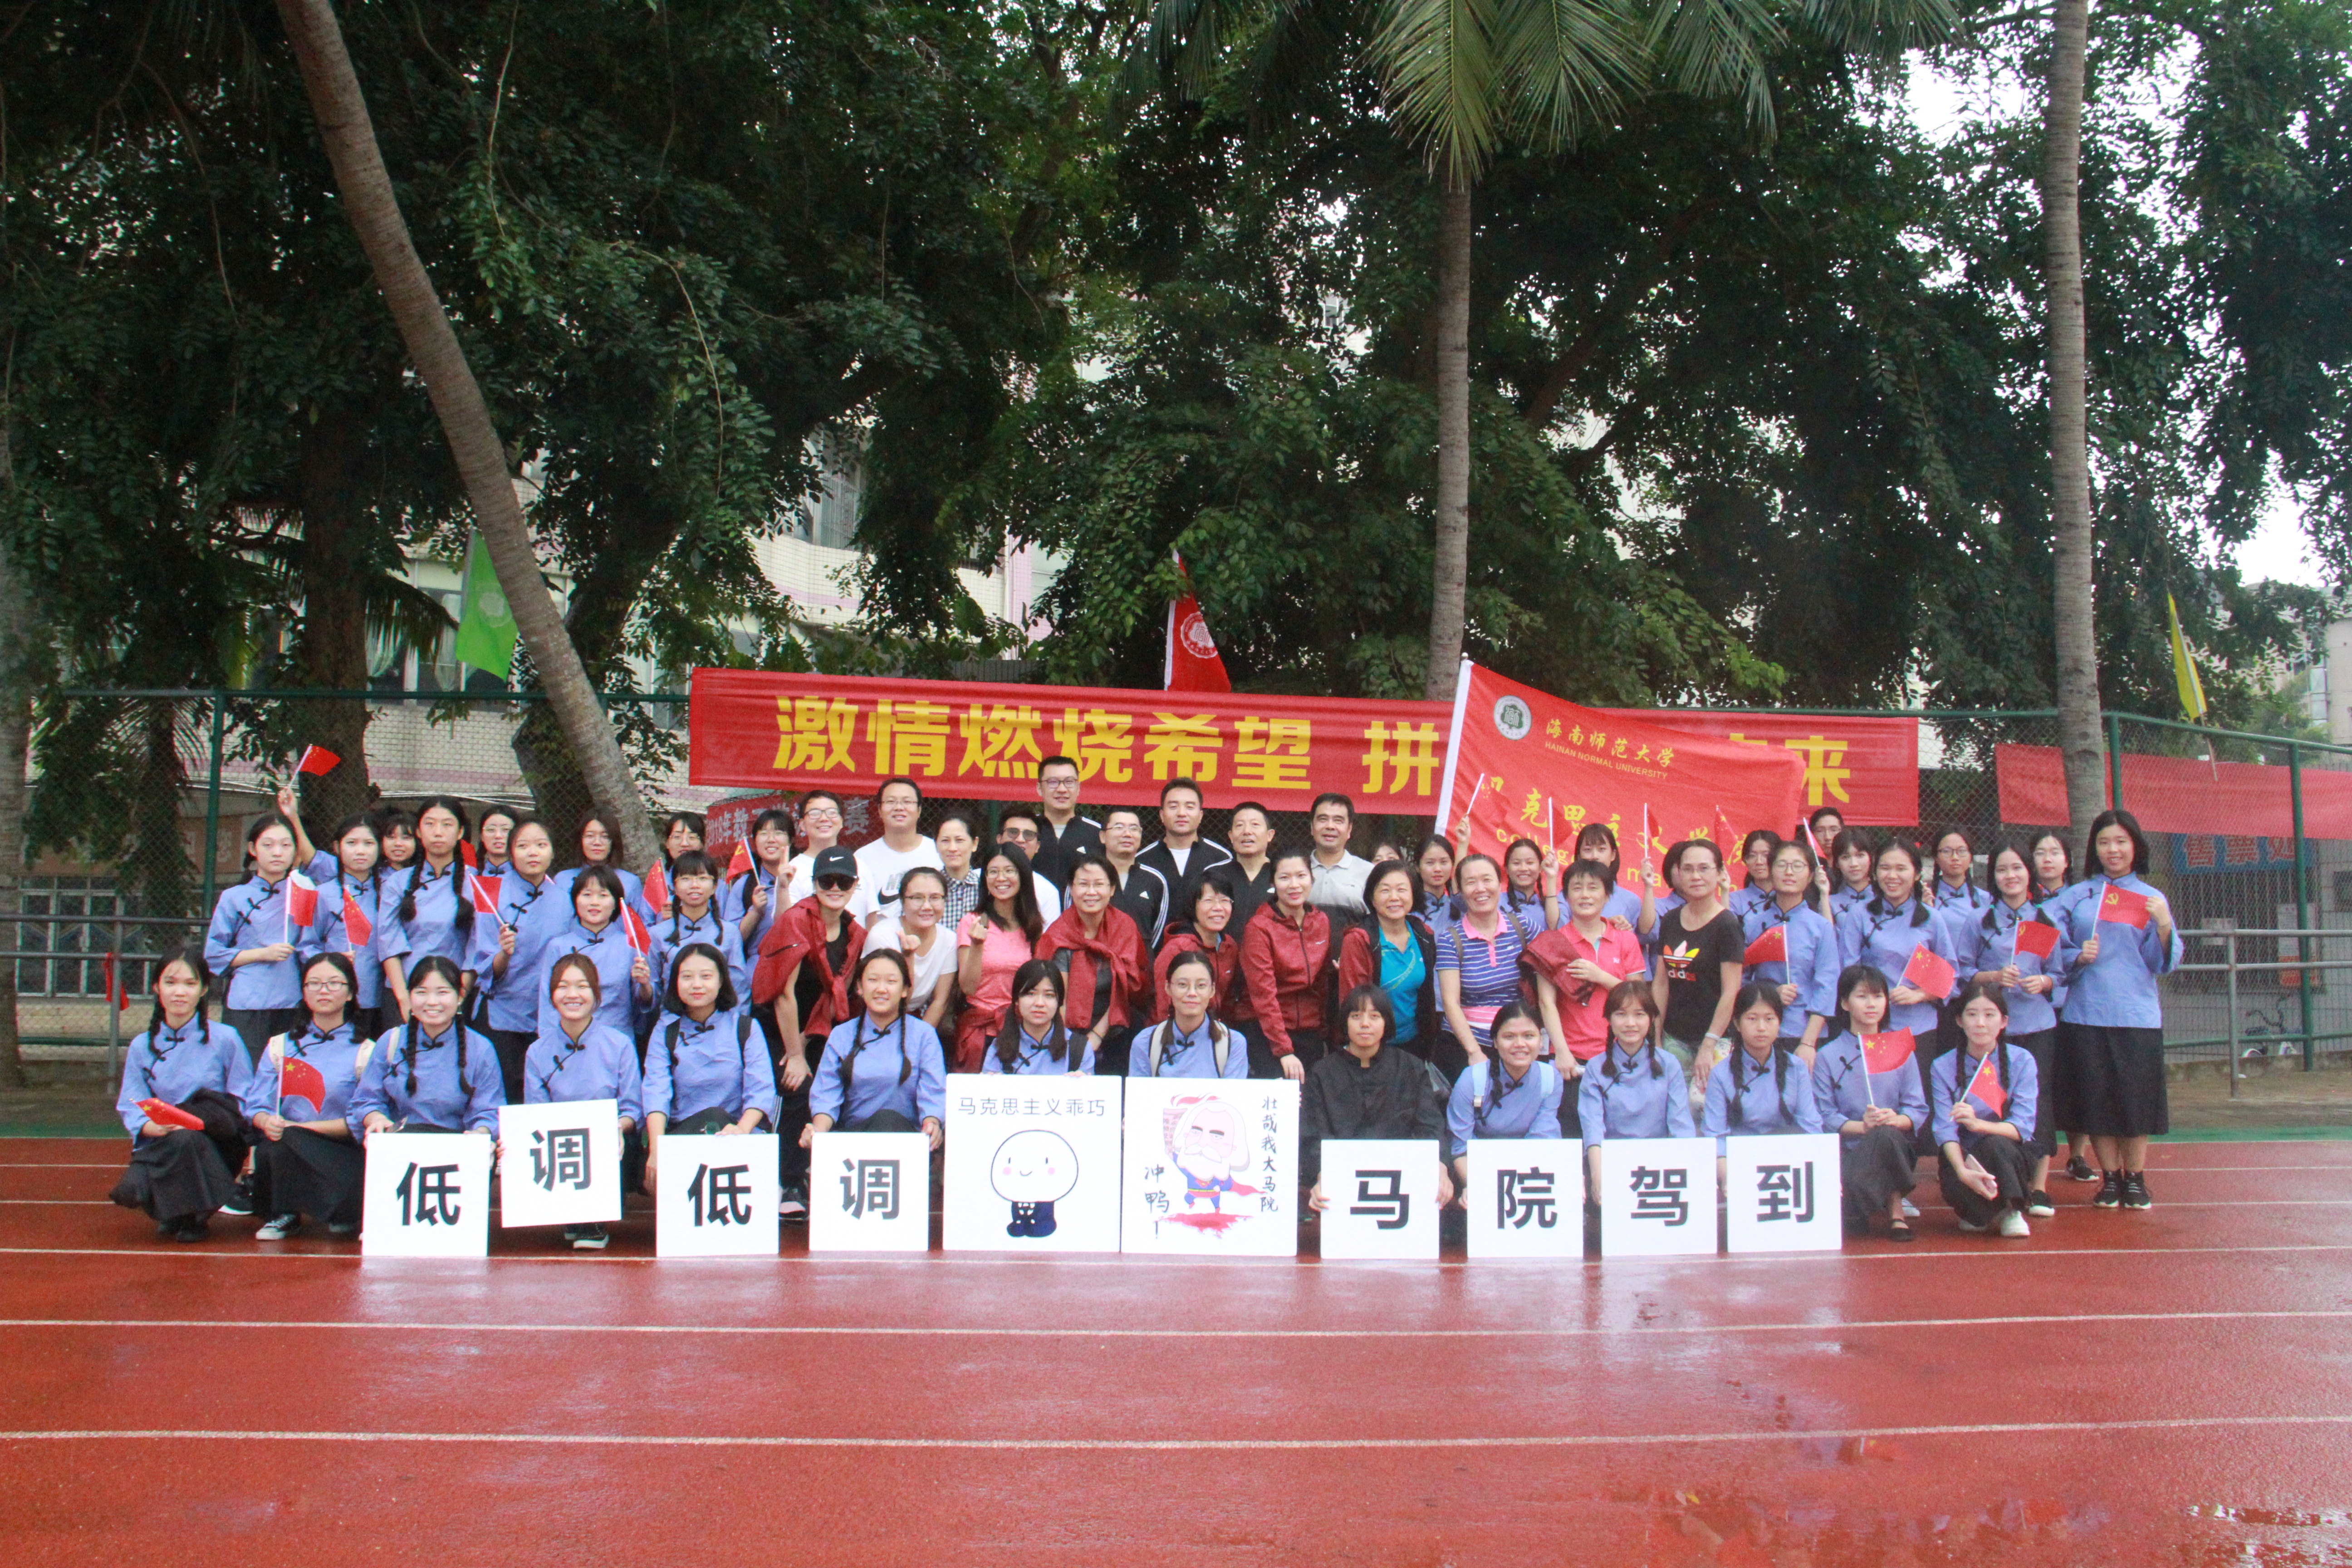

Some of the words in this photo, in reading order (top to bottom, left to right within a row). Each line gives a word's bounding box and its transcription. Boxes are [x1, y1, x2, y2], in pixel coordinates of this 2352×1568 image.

[773, 695, 1311, 789] 激情燃烧希望
[1545, 741, 1576, 757] HAINAN
[1578, 752, 1613, 768] NORMAL
[1616, 762, 1668, 779] UNIVERSITY
[1547, 719, 1675, 767] 海南师范大学
[958, 1097, 1105, 1117] 马克思主义乖巧
[530, 1128, 591, 1191] 调
[1260, 1095, 1279, 1212] 壮哉我大马院
[396, 1162, 461, 1226] 低
[687, 1163, 752, 1227] 低
[839, 1158, 900, 1220] 调
[1350, 1170, 1410, 1230] 马
[1497, 1167, 1558, 1229] 院
[1630, 1166, 1689, 1226] 驾
[1756, 1161, 1814, 1223] 到
